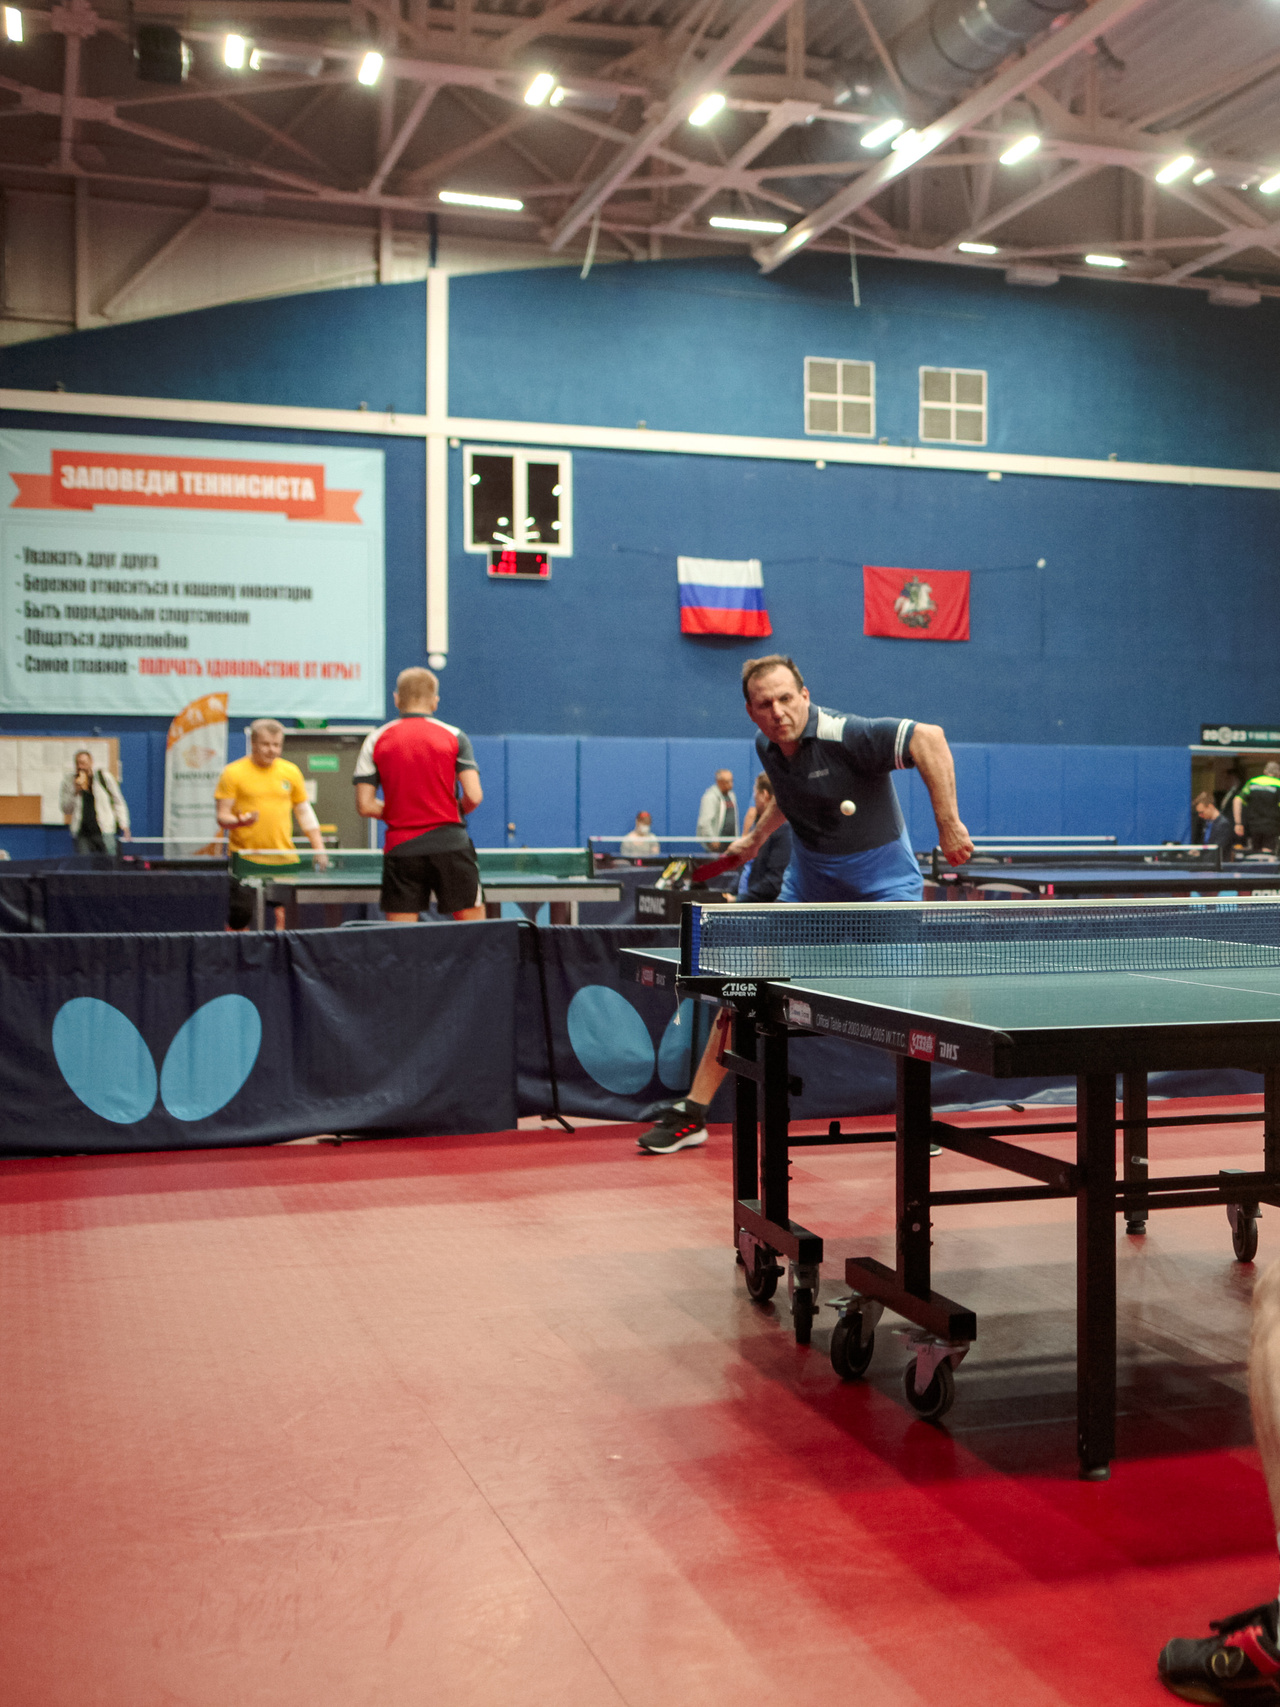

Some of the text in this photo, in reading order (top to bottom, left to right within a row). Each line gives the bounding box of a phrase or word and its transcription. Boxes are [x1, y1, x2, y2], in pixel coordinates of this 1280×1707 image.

[60, 465, 316, 501] ЗАПОВЕДИ ТЕННИСИСТА
[120, 553, 159, 570] друга
[24, 600, 61, 620] Быть
[25, 627, 95, 647] Общаться
[25, 654, 69, 673] Самое
[721, 983, 757, 991] STIGA
[939, 1041, 960, 1061] DHS
